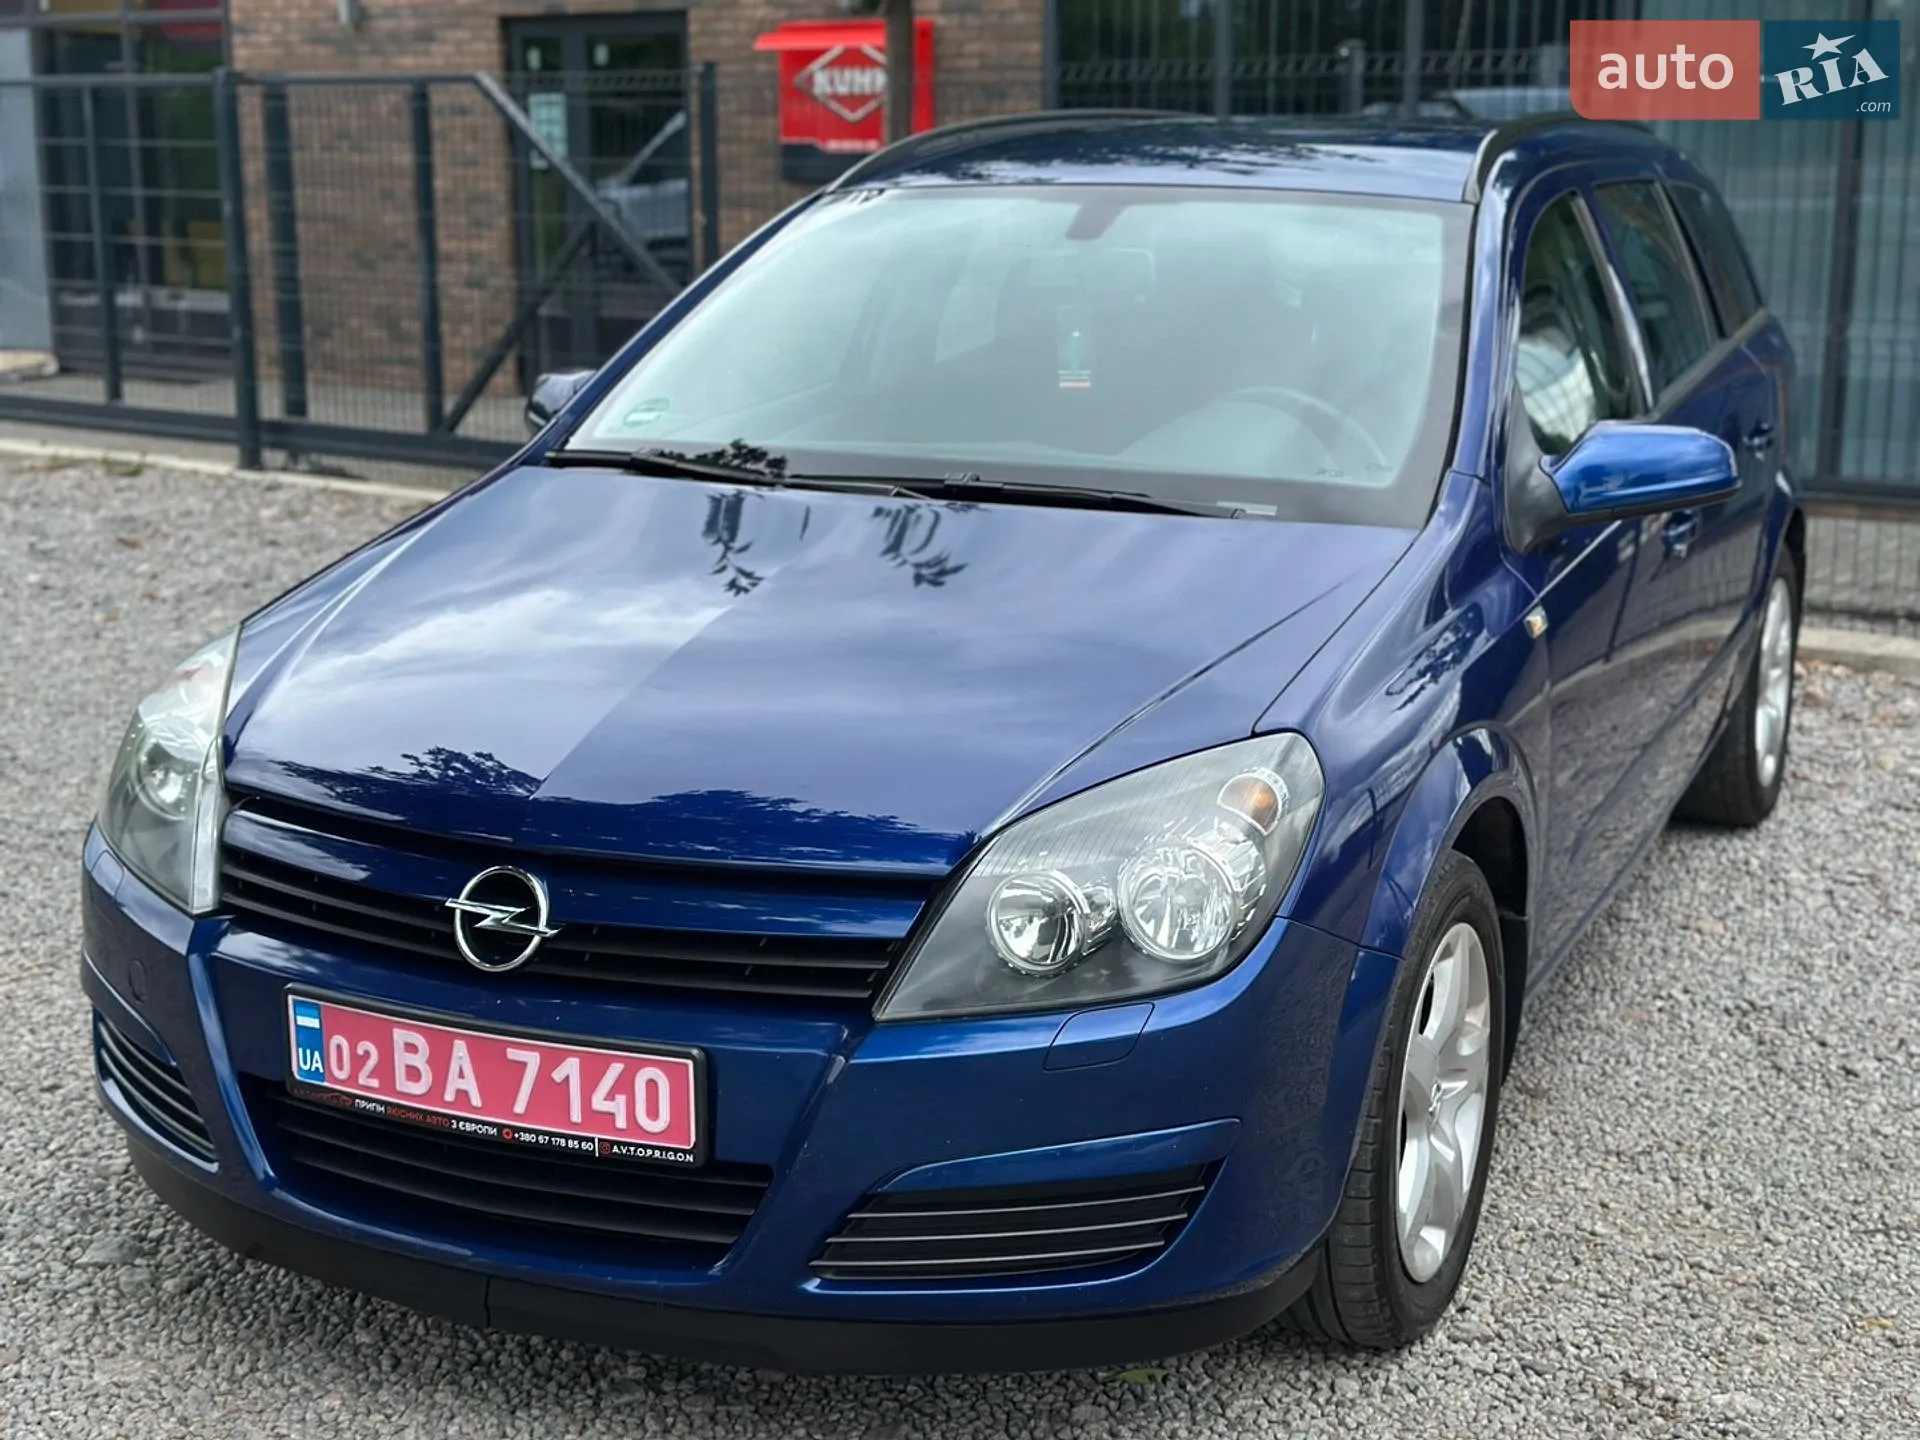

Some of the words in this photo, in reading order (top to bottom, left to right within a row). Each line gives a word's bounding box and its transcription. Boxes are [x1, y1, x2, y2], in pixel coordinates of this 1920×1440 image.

[298, 1047, 324, 1073] UA
[329, 1034, 380, 1089] 02
[506, 1047, 671, 1134] 7140
